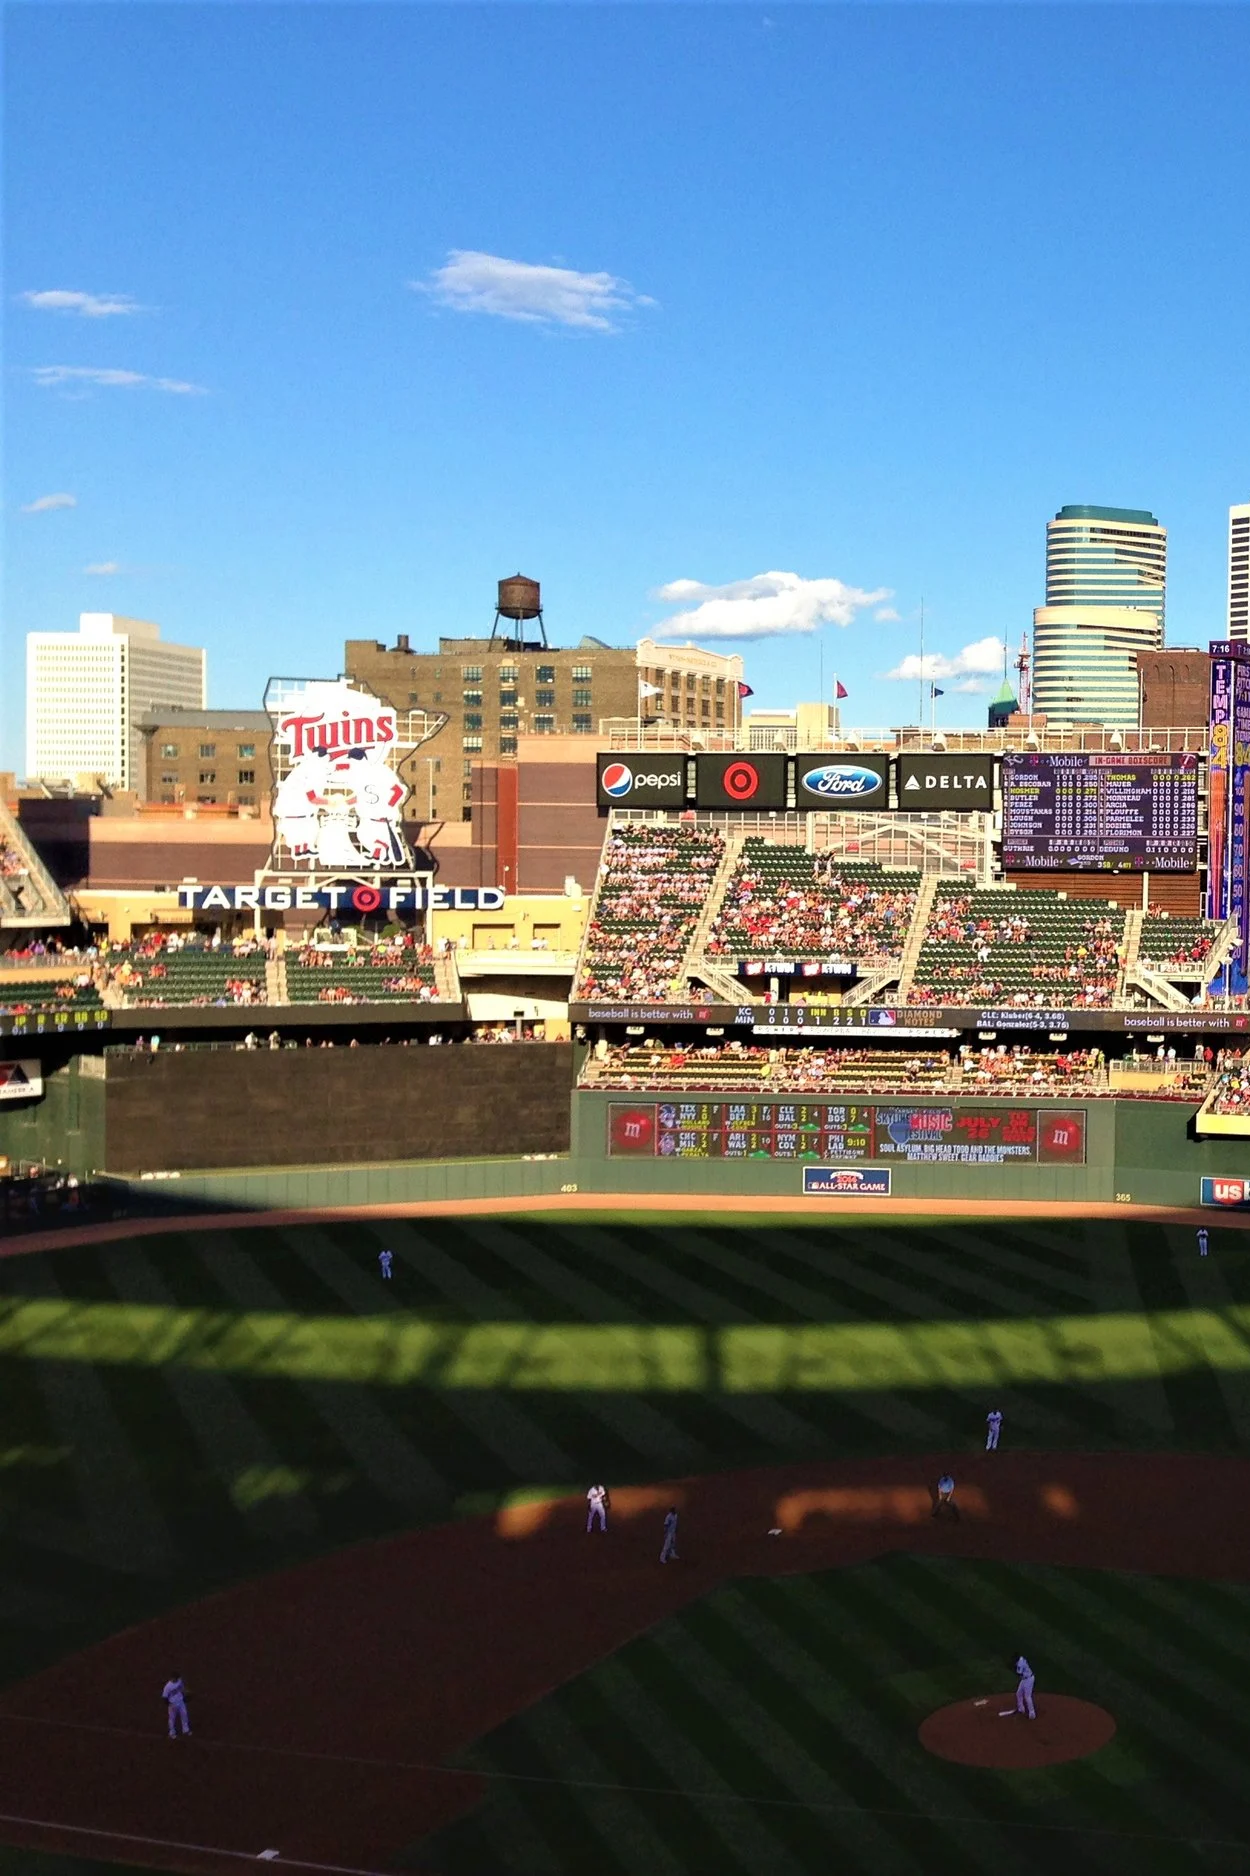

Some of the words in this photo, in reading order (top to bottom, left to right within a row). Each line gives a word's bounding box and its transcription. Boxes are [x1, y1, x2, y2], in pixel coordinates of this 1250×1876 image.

[1212, 645, 1229, 653] 7:16
[1213, 665, 1228, 724] TEMP
[281, 710, 393, 761] Twins
[1049, 756, 1083, 767] Mobile
[634, 771, 681, 790] pepsi
[817, 770, 865, 793] Ford
[926, 775, 987, 789] DELTA
[1025, 856, 1059, 867] Mobile
[1154, 857, 1190, 869] Mobile
[177, 885, 347, 910] TARGET
[390, 887, 506, 910] FIELD
[588, 1008, 629, 1018] baseball
[631, 1008, 639, 1018] is
[640, 1008, 670, 1019] better
[672, 1009, 693, 1019] with
[738, 1008, 752, 1016] KC
[810, 1009, 827, 1017] INN
[897, 1010, 943, 1019] DIAMOND
[982, 1011, 998, 1019] CLE:
[735, 1016, 755, 1024] MIN
[904, 1018, 935, 1026] NOTES
[977, 1020, 994, 1028] BAL:
[1124, 1016, 1165, 1027] baseball
[1167, 1016, 1175, 1027] is
[1176, 1017, 1206, 1028] better
[1208, 1018, 1230, 1028] with
[679, 1105, 696, 1113] TEX
[729, 1105, 746, 1113] LAA
[779, 1106, 795, 1114] CLE
[828, 1107, 845, 1115] TOR
[956, 1117, 1001, 1128] JULY
[679, 1132, 696, 1140] CHC
[729, 1133, 745, 1141] ARI
[777, 1134, 797, 1142] NYM
[829, 1134, 845, 1142] PHI
[1053, 1129, 1069, 1145] m
[679, 1140, 695, 1148] MIL
[728, 1141, 747, 1149] WAS
[848, 1138, 866, 1147] 9:10
[879, 1144, 895, 1152] SOUL
[924, 1144, 935, 1153] BIG
[935, 1145, 952, 1154] HEAD
[953, 1145, 969, 1154] TODD
[970, 1145, 983, 1154] AND
[984, 1145, 996, 1154] THE
[907, 1152, 938, 1161] MATTHEW
[960, 1153, 976, 1162] GEAR
[560, 1183, 578, 1193] 403
[820, 1182, 859, 1190] ALL-STAR
[860, 1183, 886, 1191] GAME
[1115, 1193, 1131, 1202] 365
